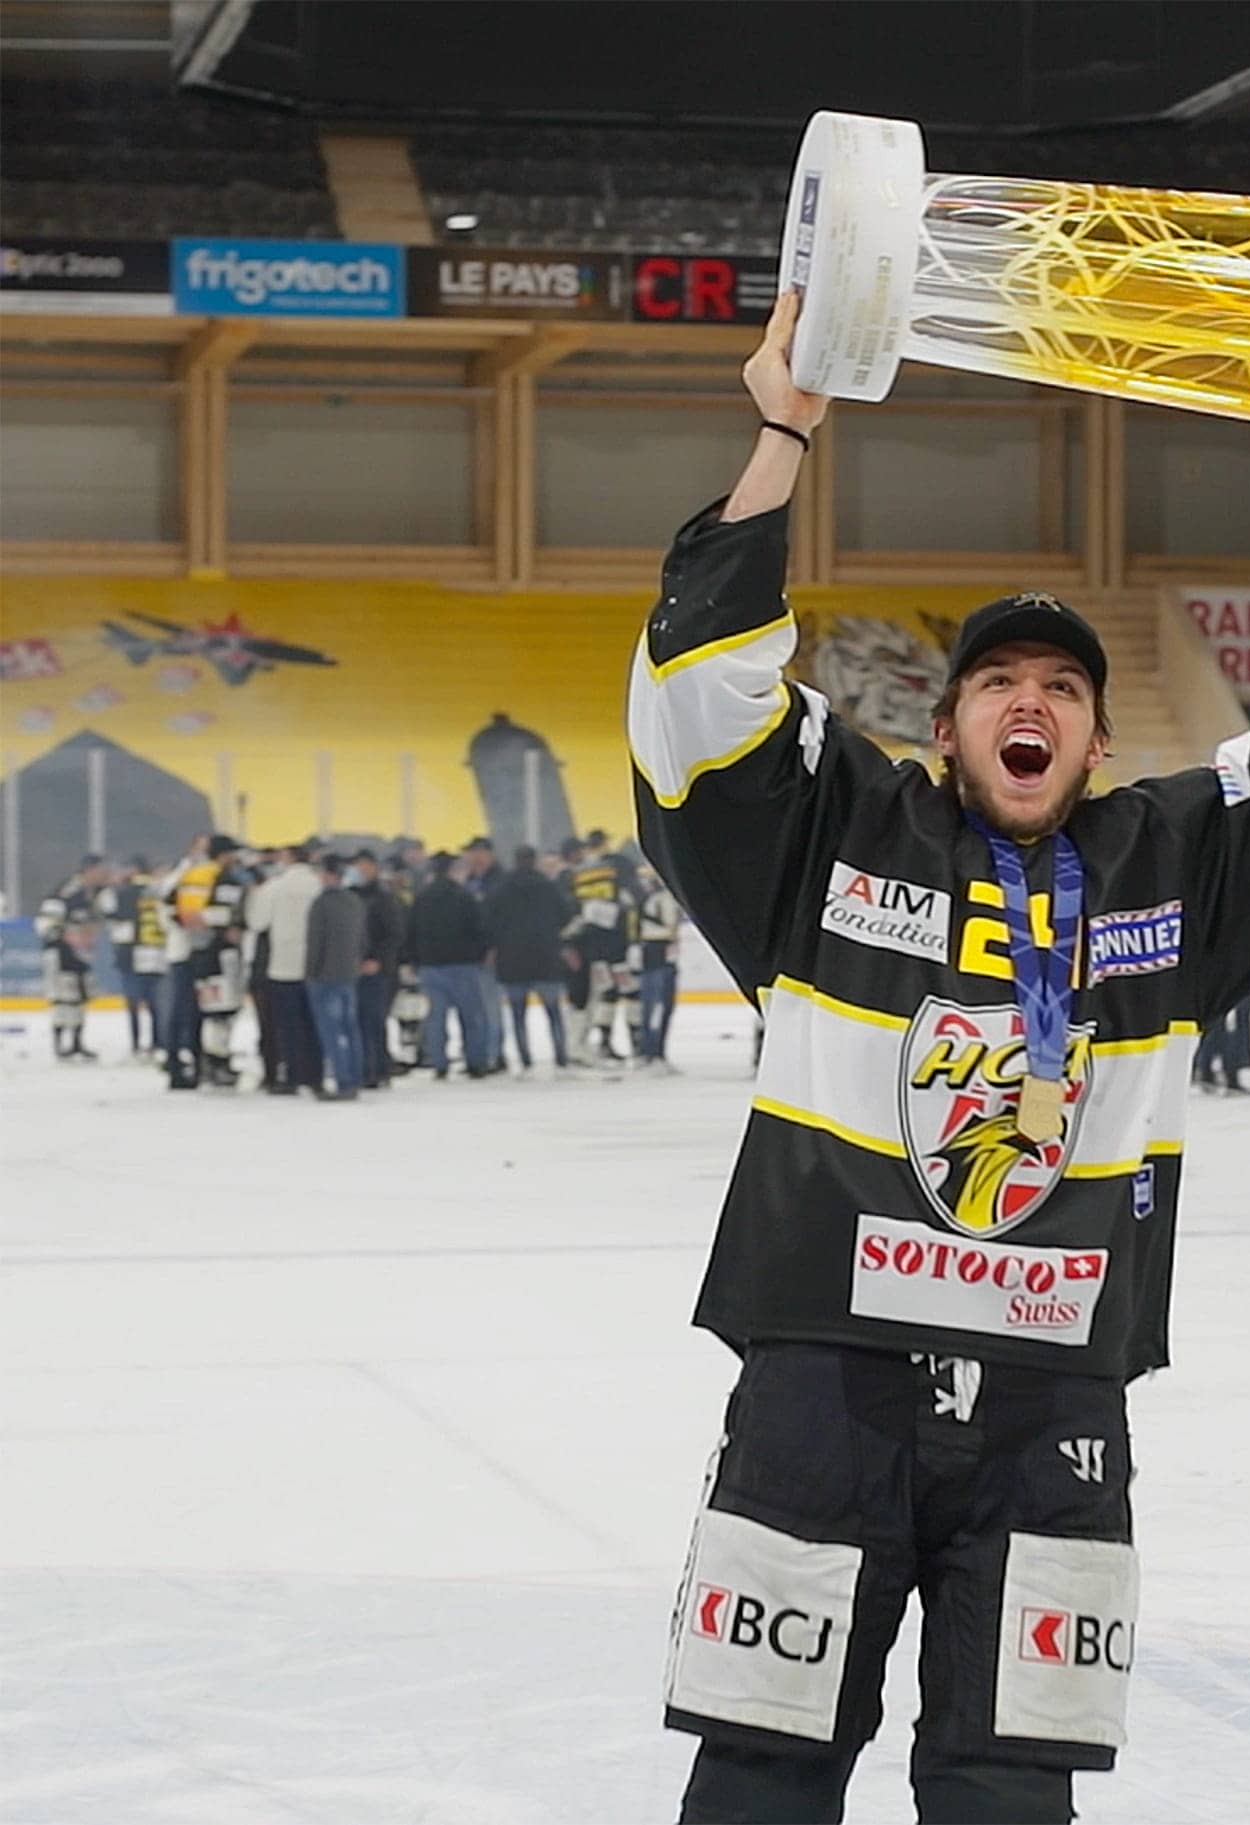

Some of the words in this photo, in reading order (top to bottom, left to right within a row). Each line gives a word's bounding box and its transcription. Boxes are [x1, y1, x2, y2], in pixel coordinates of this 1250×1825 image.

[186, 248, 391, 304] frigotech
[438, 261, 486, 294] LE
[489, 262, 580, 297] PAYS
[859, 1234, 1056, 1295] SOTOCO
[1006, 1294, 1082, 1325] Swiss
[730, 1594, 833, 1664] BCJ
